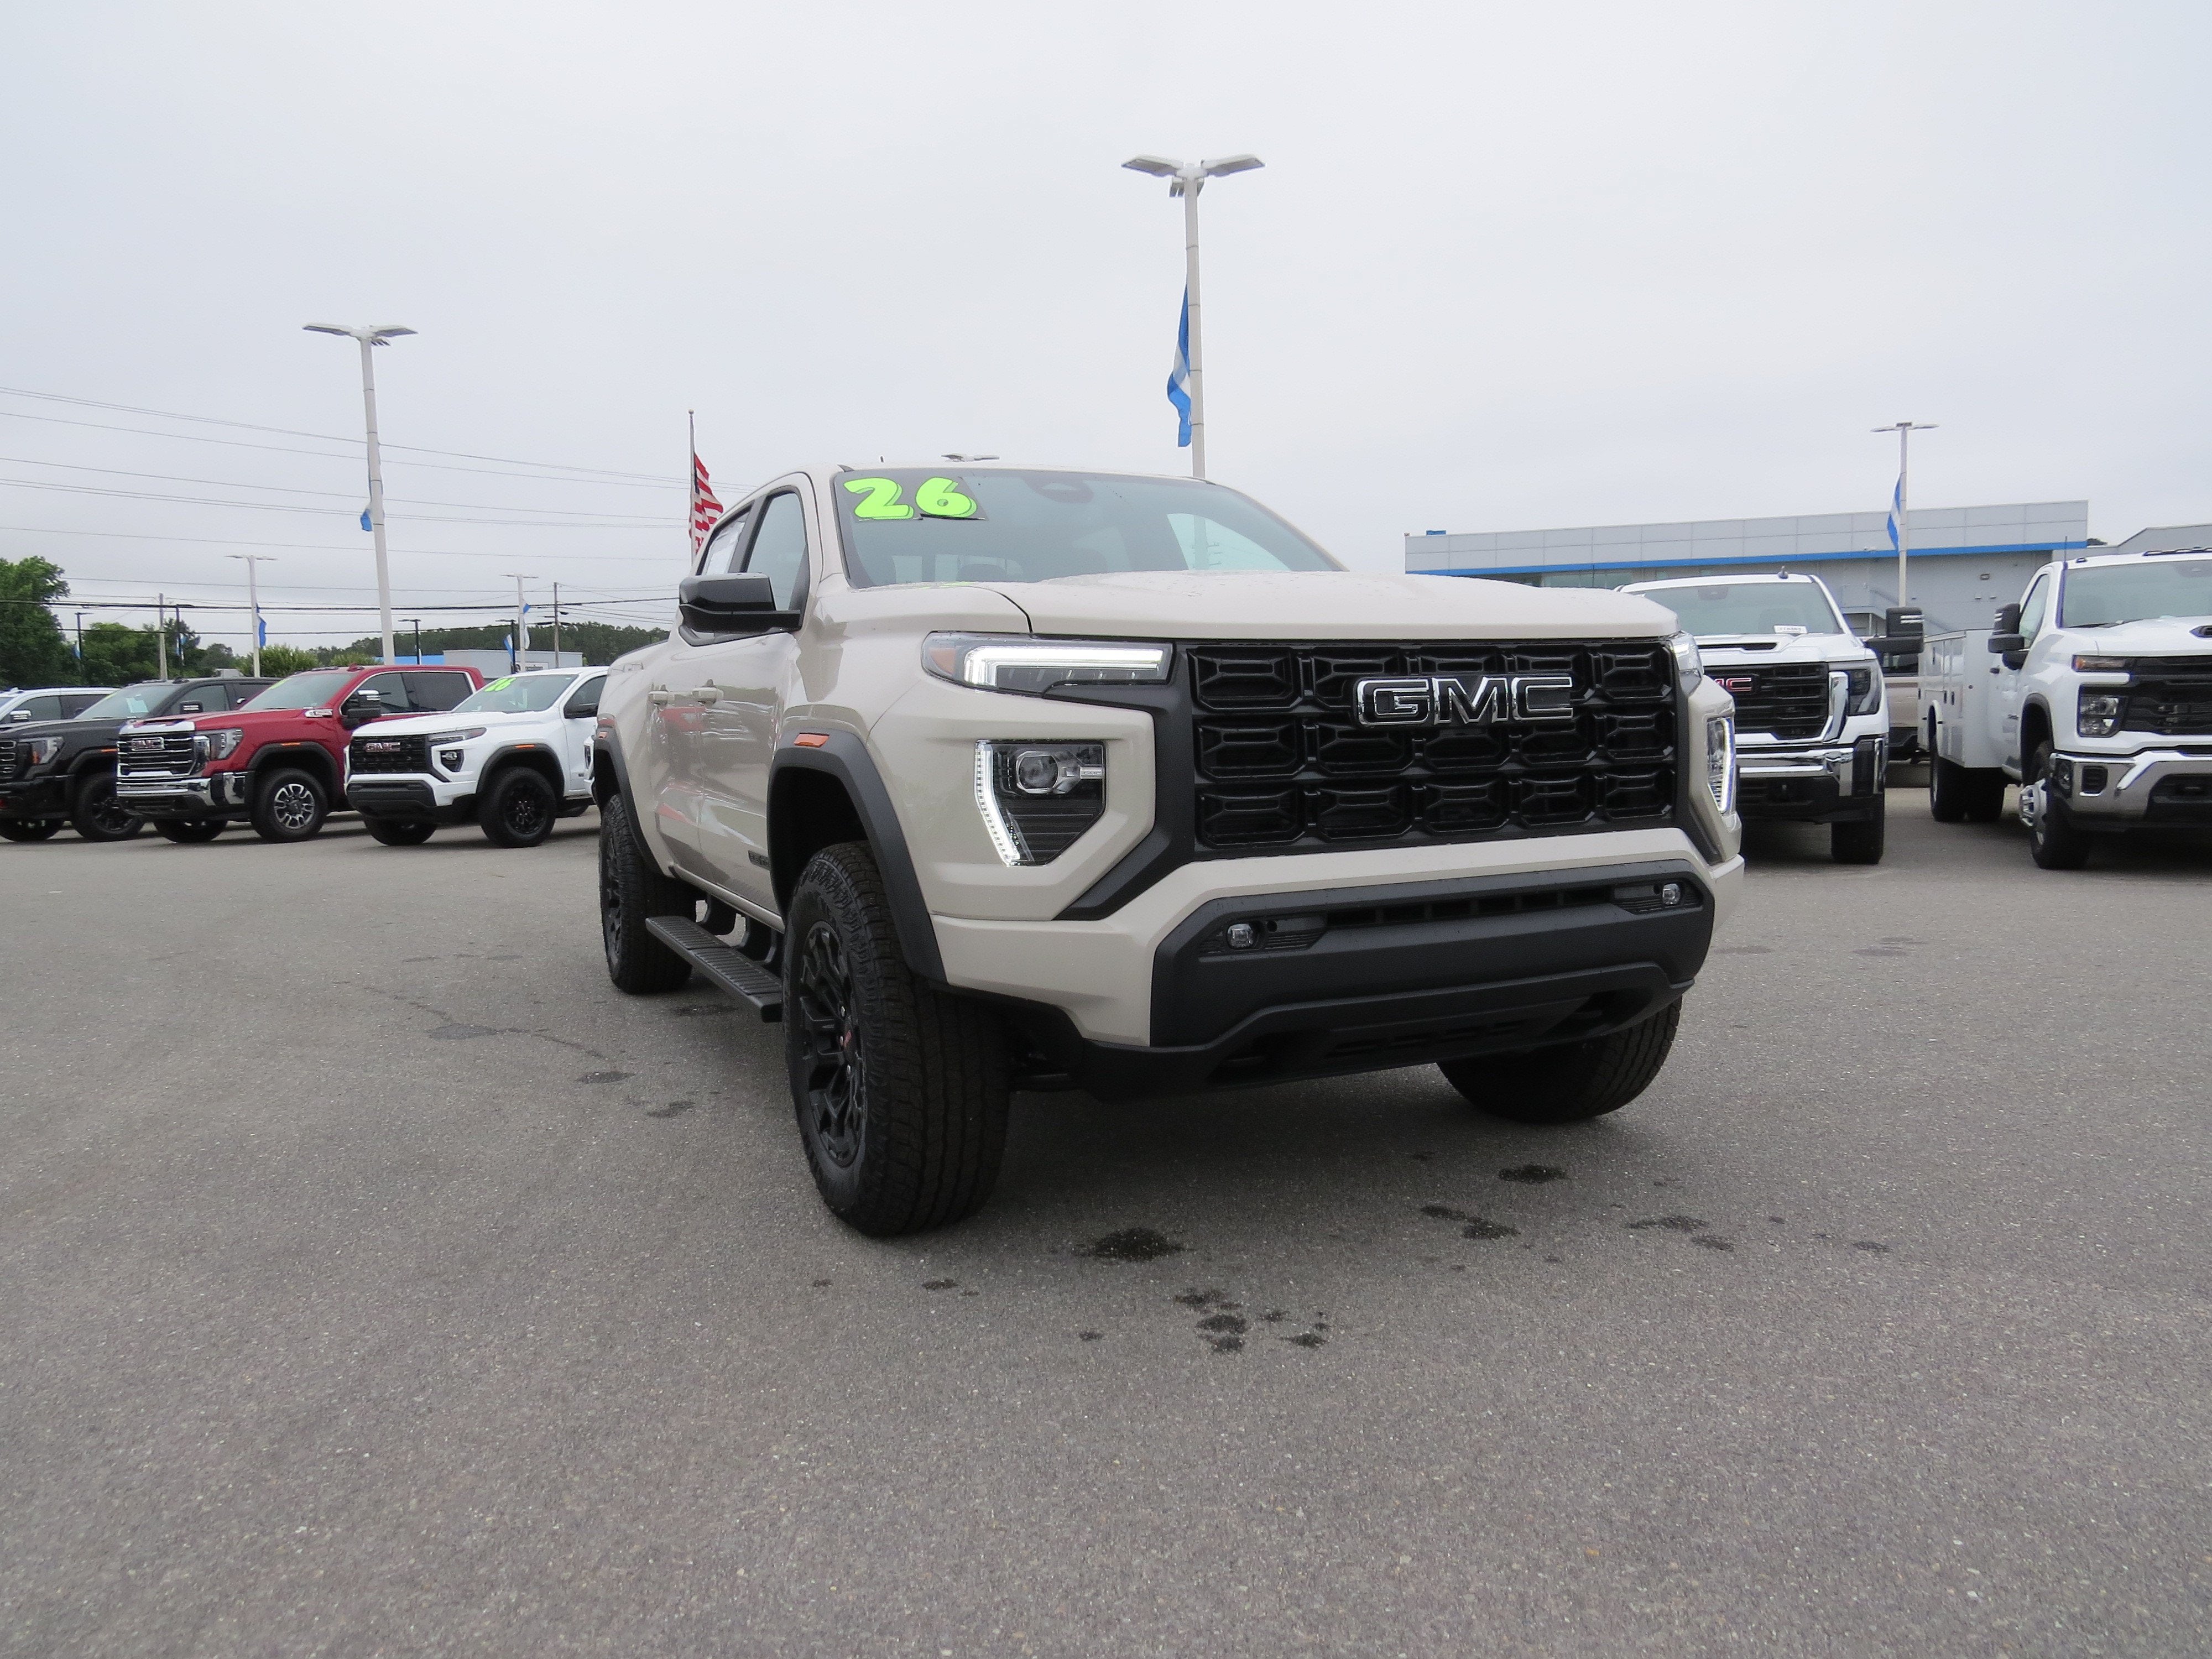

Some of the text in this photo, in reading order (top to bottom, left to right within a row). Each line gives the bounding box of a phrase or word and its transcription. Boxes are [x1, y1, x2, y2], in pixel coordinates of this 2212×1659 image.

[843, 477, 977, 519] 26
[484, 677, 517, 692] 26
[1357, 676, 1573, 725] GMC
[364, 742, 401, 753] GMC
